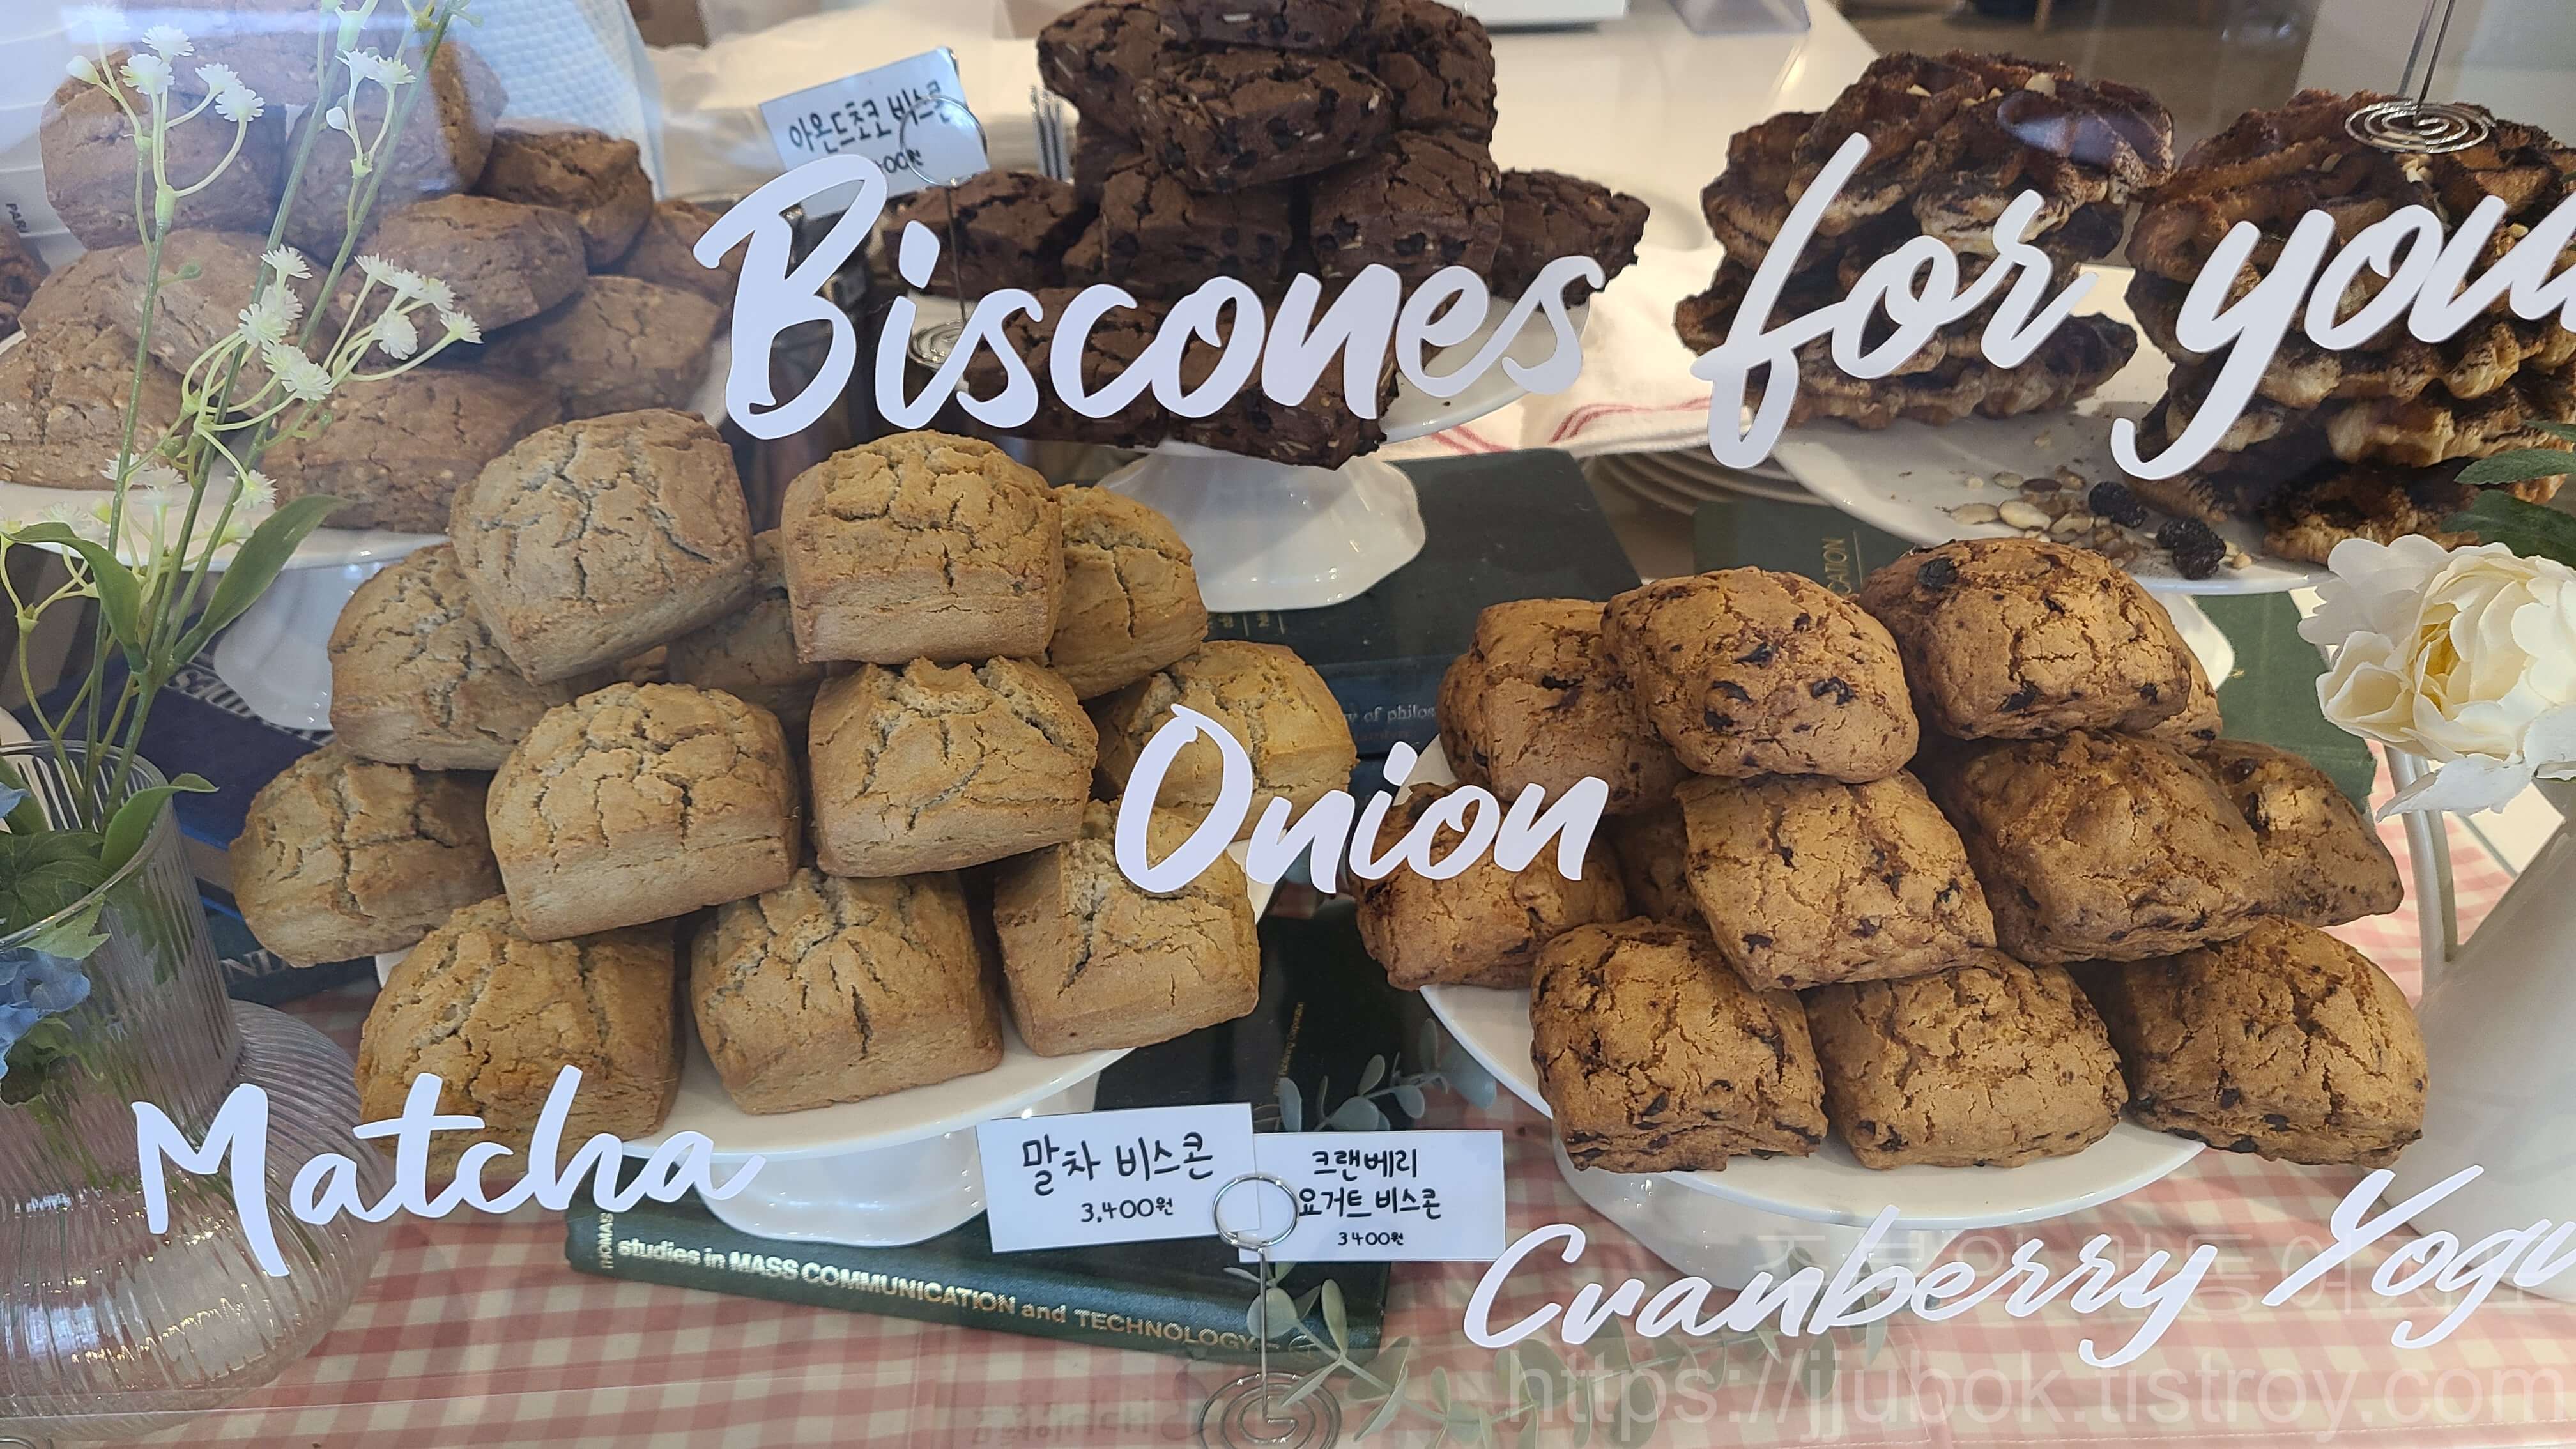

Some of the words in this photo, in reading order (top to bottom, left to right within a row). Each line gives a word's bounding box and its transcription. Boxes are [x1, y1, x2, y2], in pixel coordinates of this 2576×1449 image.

[693, 153, 1605, 440] Biscones
[1689, 131, 2098, 469] for
[1115, 703, 1609, 894] Onion
[132, 1064, 767, 1277] Matcha
[1023, 1134, 1101, 1195] 말차
[1116, 1131, 1213, 1181] 비스콘
[1080, 1197, 1173, 1223] 3,400원
[1299, 1186, 1372, 1218] 요거트
[1376, 1186, 1441, 1219] 비스콘
[1312, 1149, 1417, 1181] 크랜베리
[617, 1238, 700, 1265] studies
[704, 1248, 726, 1269] in
[728, 1251, 798, 1280] MASS
[801, 1262, 1016, 1314] COMMUNICATION
[1022, 1303, 1066, 1324] and
[1074, 1308, 1257, 1351] TECHNOLOGY
[1463, 1204, 2218, 1368] Cranberry
